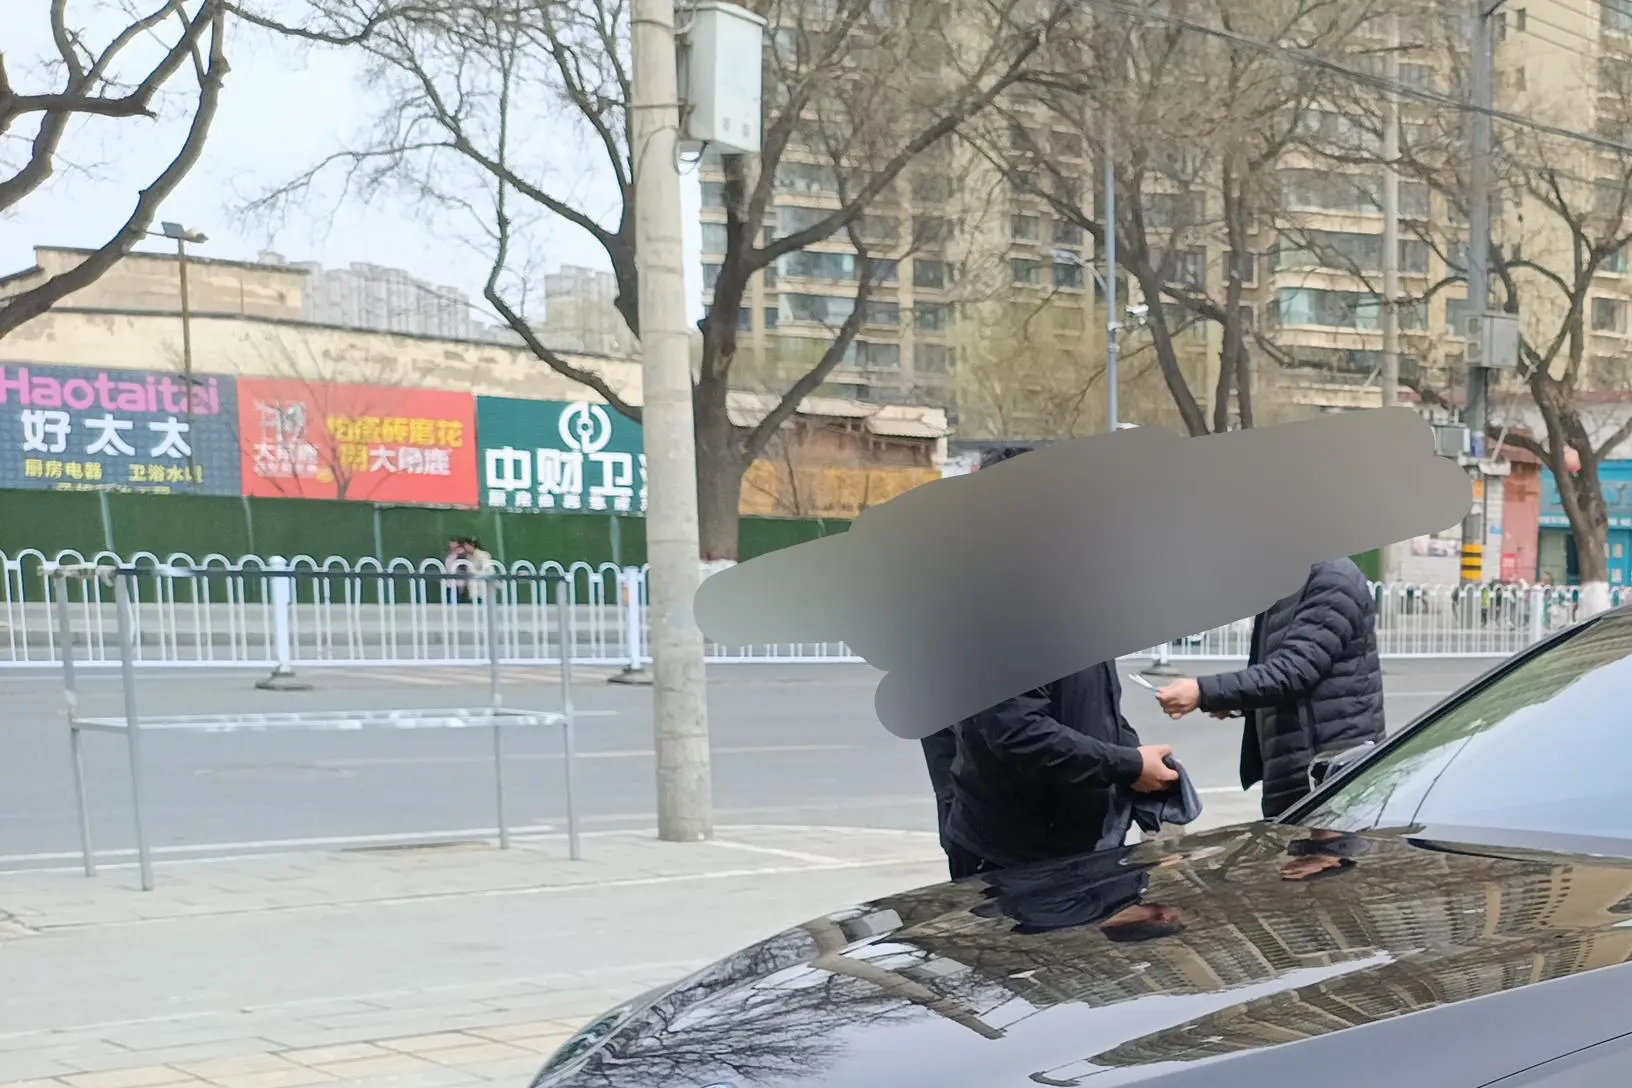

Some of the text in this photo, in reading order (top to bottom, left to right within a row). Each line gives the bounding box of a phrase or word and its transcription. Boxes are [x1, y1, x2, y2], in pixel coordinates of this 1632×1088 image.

[0, 367, 220, 415] Haotaitai
[20, 408, 193, 459] 好太太
[24, 458, 103, 480] 厨房电器
